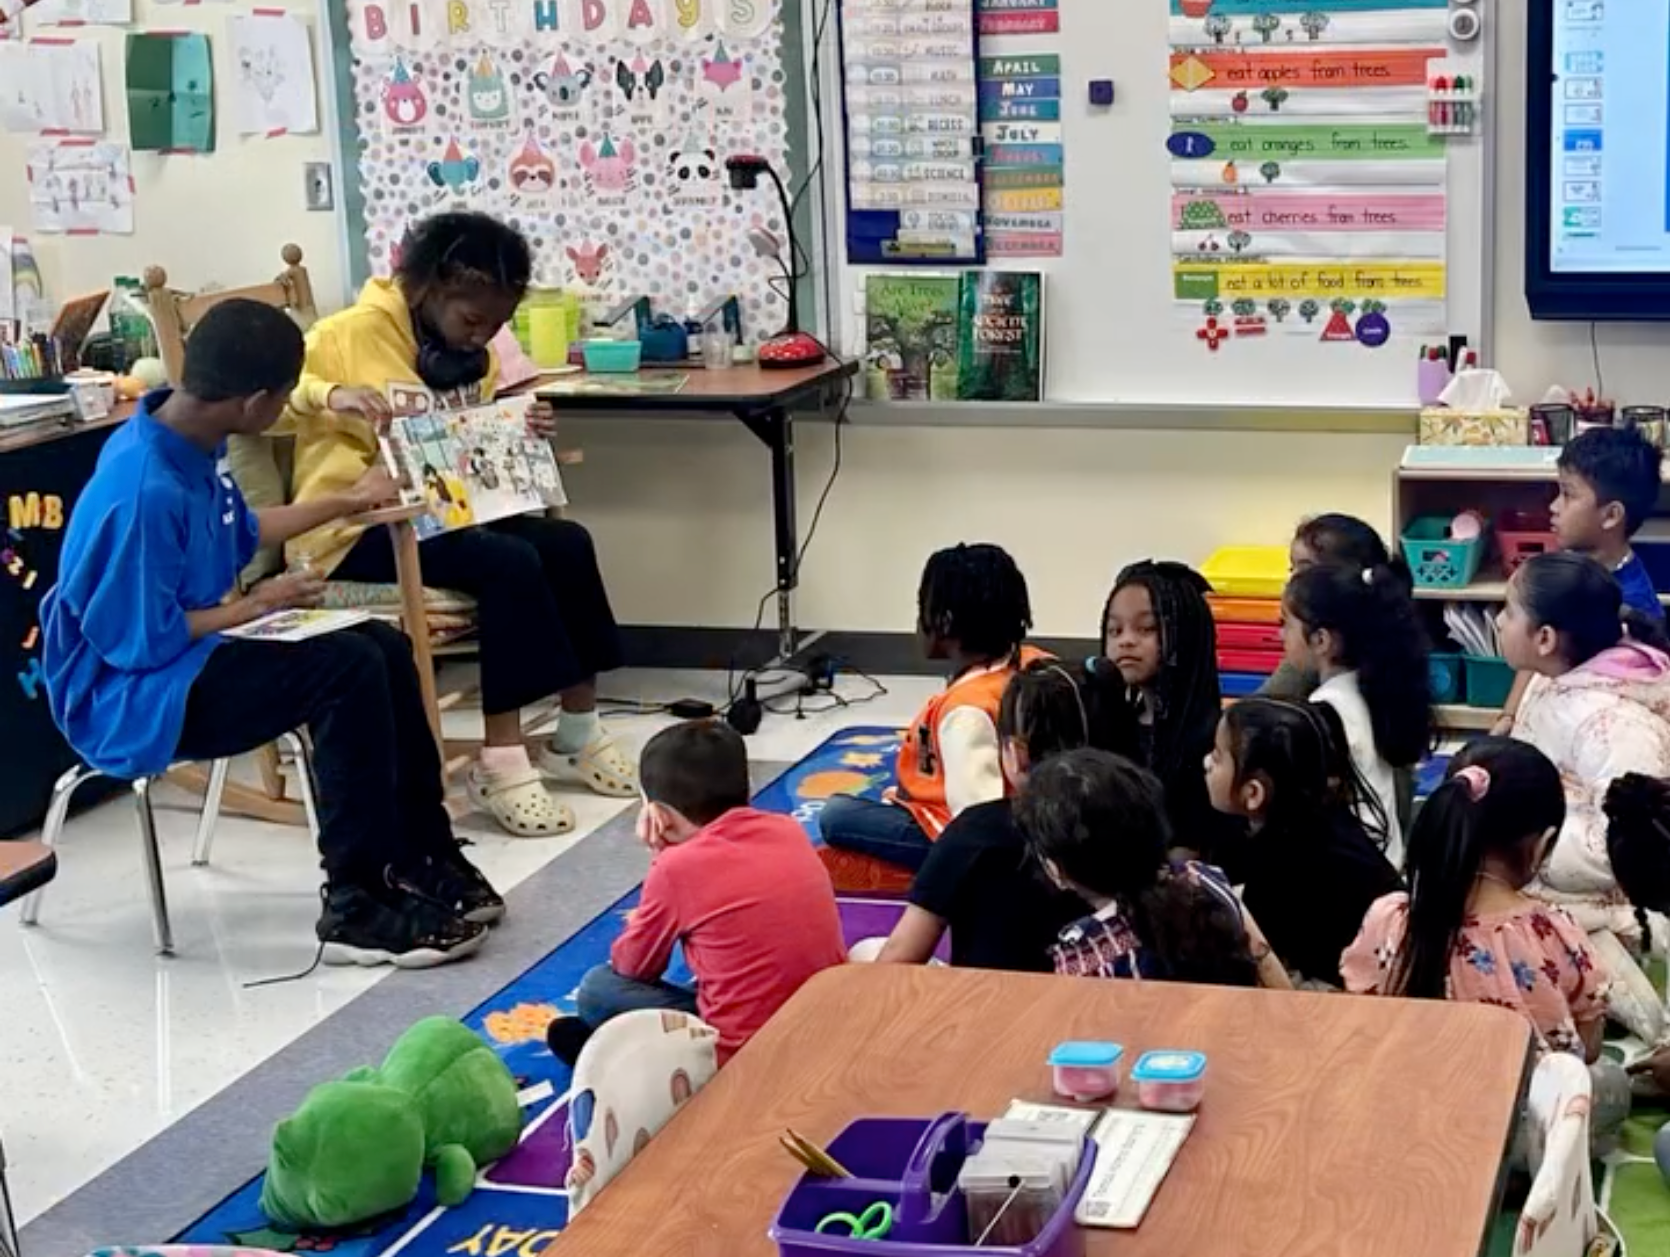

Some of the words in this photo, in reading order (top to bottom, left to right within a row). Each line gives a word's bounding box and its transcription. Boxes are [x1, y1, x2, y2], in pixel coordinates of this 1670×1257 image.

[993, 60, 1041, 75] APRIL
[1227, 61, 1252, 79] eat
[1258, 64, 1300, 82] apples
[1310, 58, 1345, 81] from
[1002, 83, 1034, 97] MAY
[999, 101, 1038, 117] JUNE
[996, 125, 1039, 140] JULY
[1230, 138, 1252, 152] eat
[1261, 140, 1315, 156] oranges
[1330, 131, 1361, 152] from
[1227, 209, 1252, 224] eat
[1261, 210, 1318, 225] cherries
[1327, 203, 1355, 225] from
[1253, 278, 1263, 290] a
[1268, 270, 1285, 290] lot
[1290, 270, 1309, 289] of
[1316, 270, 1345, 289] food
[1354, 269, 1385, 289] from
[8, 491, 64, 530] MB
